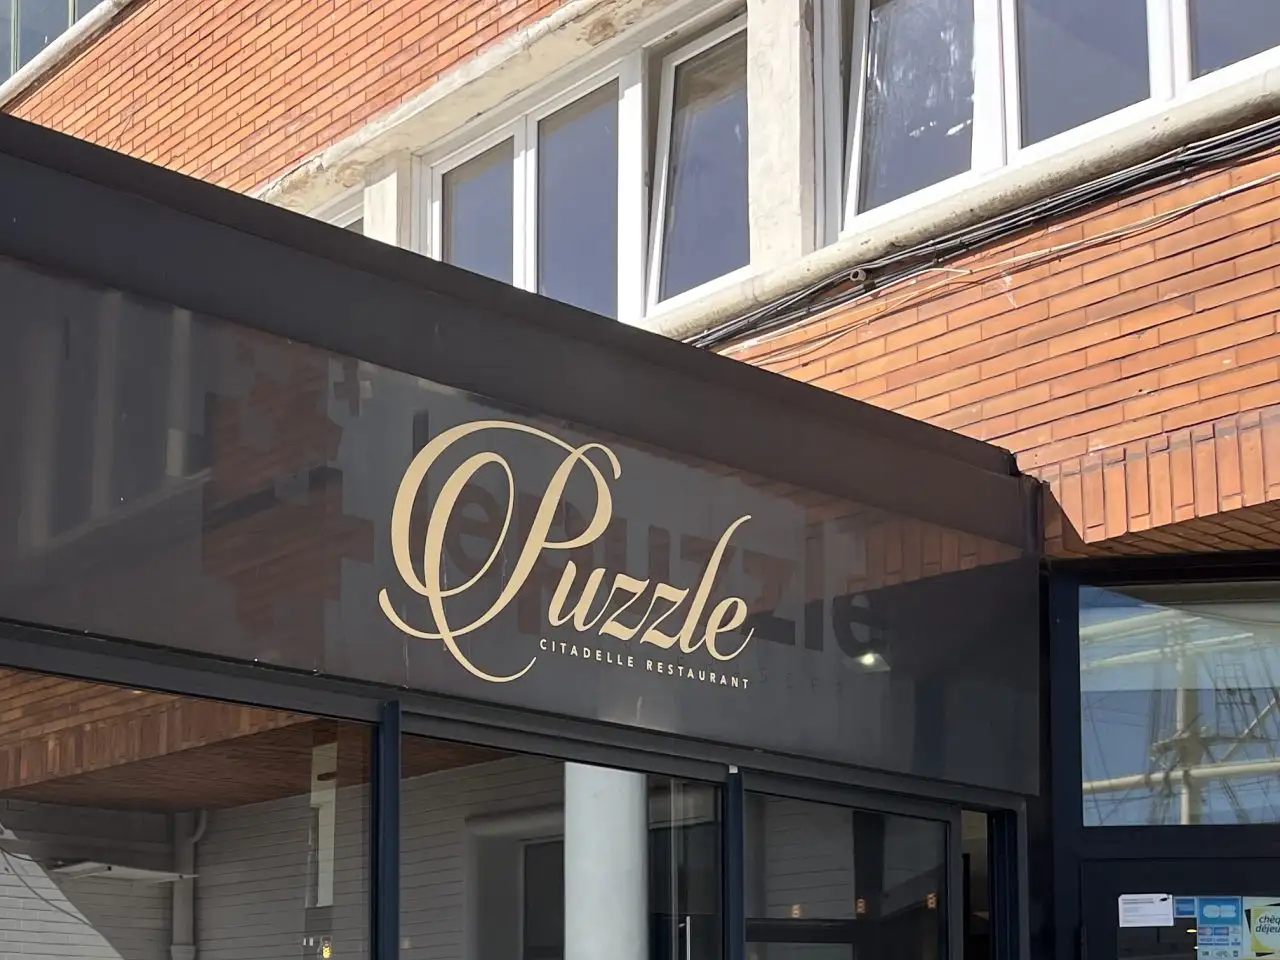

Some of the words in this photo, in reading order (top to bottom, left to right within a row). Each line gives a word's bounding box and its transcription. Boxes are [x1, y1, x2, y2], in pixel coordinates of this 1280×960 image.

[378, 420, 754, 682] Puzzle
[539, 638, 634, 668] CITADELLE
[646, 659, 749, 689] RESTAURANT
